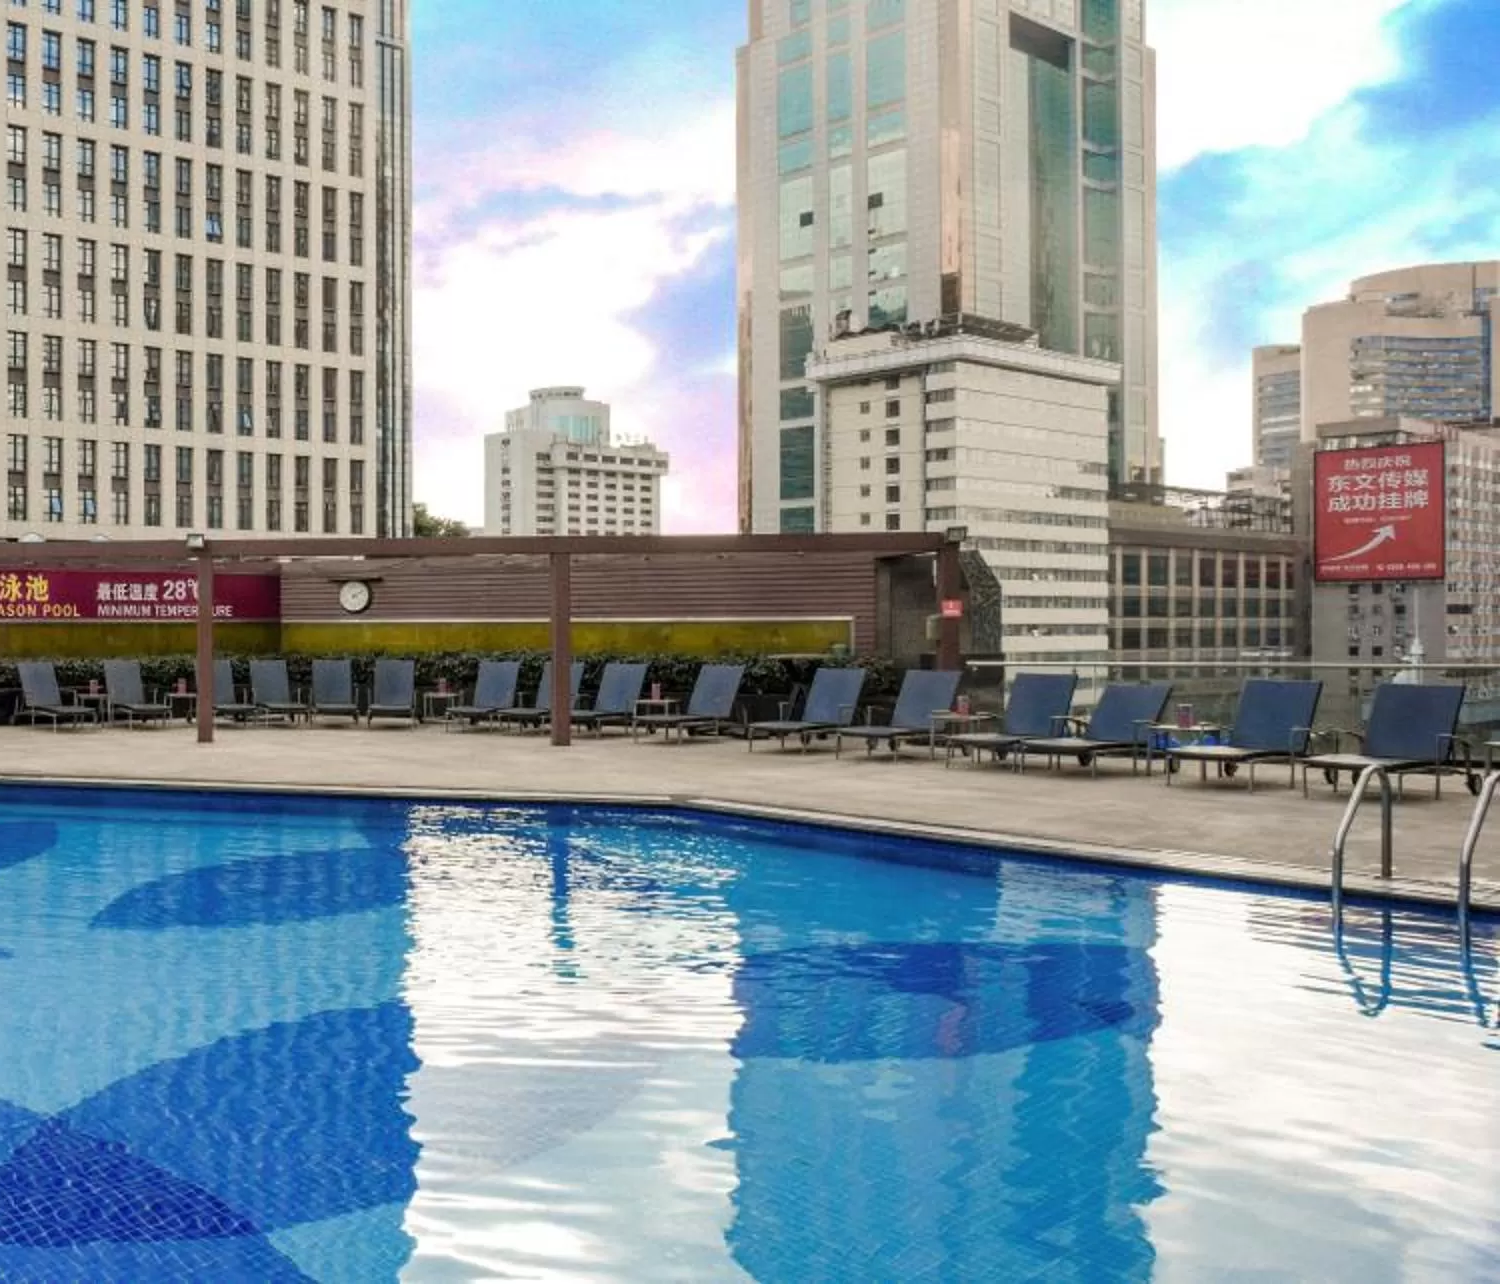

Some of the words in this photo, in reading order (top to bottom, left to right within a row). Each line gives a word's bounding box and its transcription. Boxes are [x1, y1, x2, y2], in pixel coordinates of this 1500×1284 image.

[1344, 455, 1412, 470] 热烈庆祝
[1327, 469, 1428, 492] 东文传媒
[1327, 490, 1428, 513] 成功挂牌
[97, 582, 159, 601] 最低温度
[43, 604, 81, 617] POOL
[97, 604, 152, 617] MINIMUM
[155, 605, 233, 617] TEMPERURE
